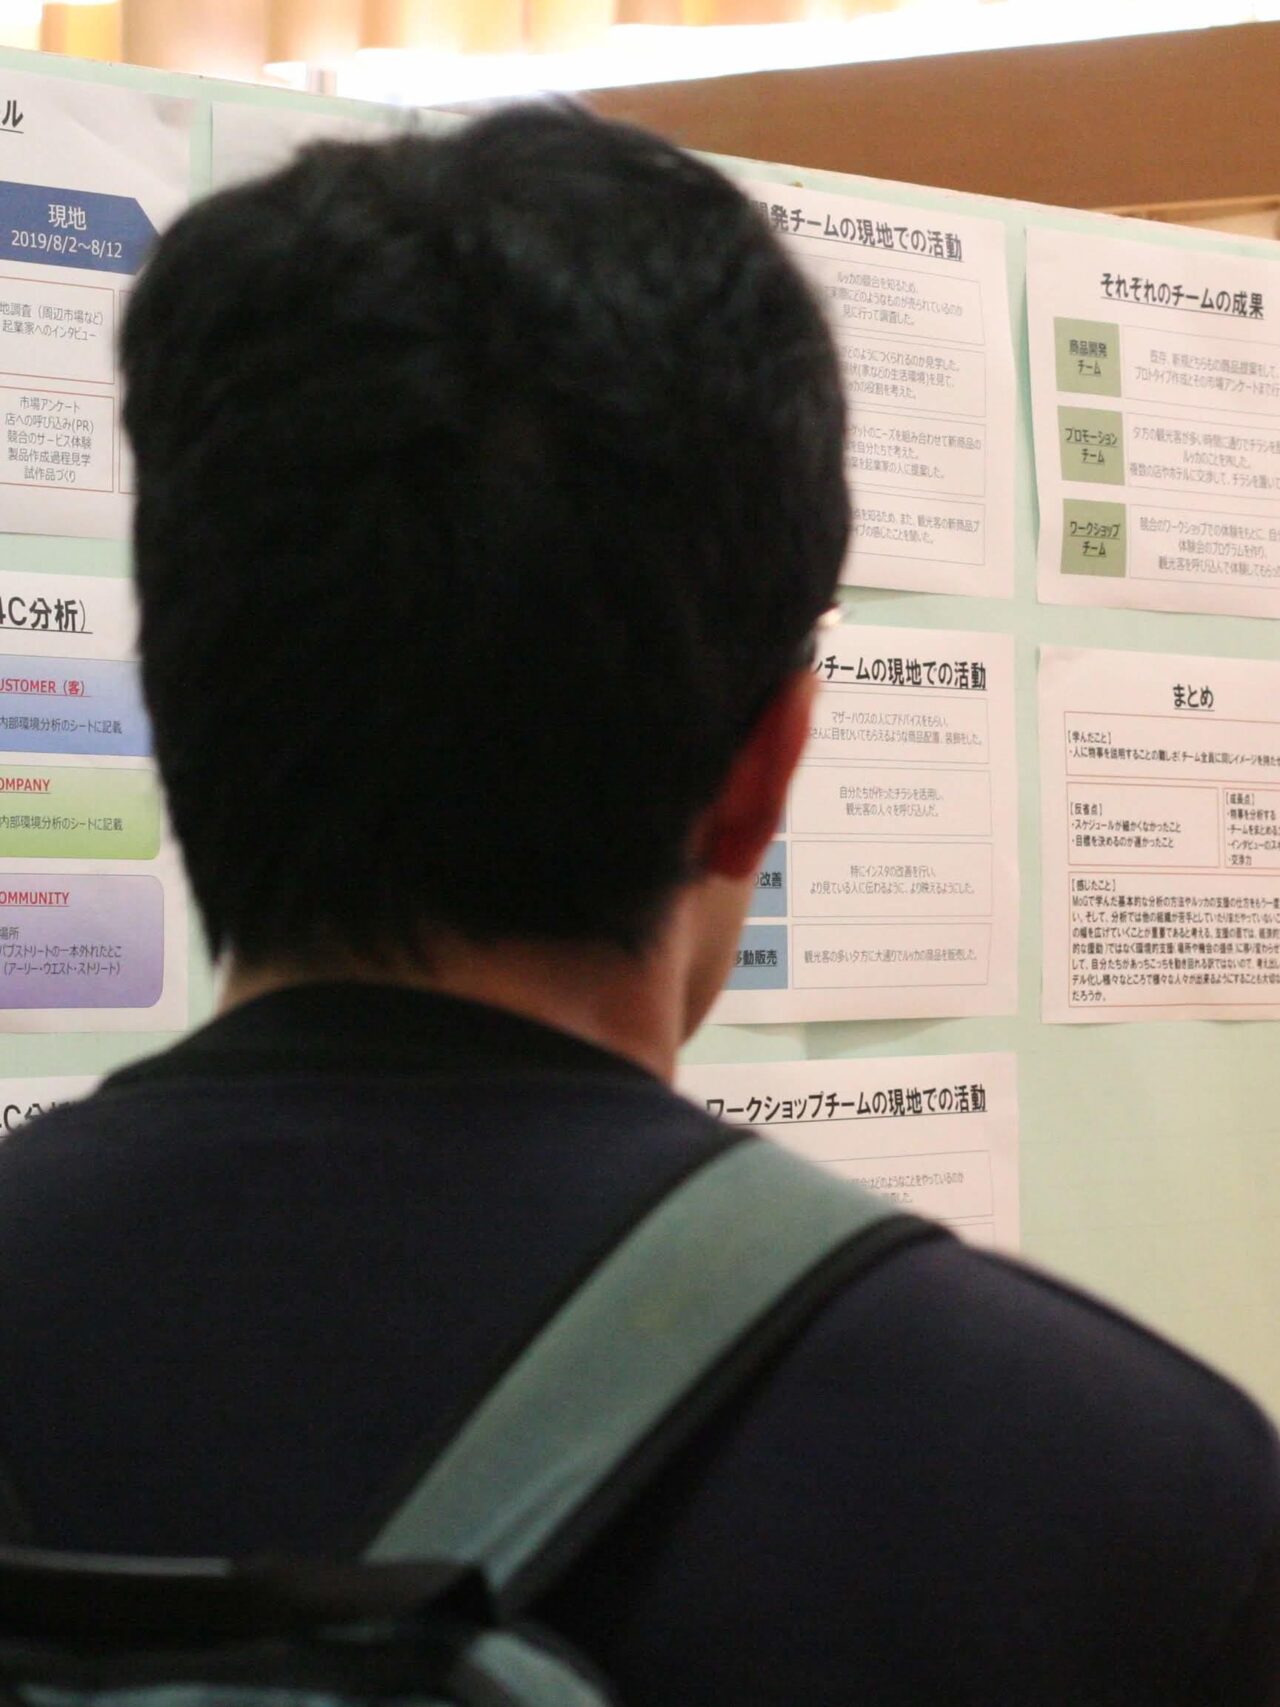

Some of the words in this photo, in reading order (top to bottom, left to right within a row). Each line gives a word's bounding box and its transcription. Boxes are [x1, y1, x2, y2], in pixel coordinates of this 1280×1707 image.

[48, 203, 87, 231] 現地
[1100, 273, 1264, 318] それぞれのチームの成果
[2, 319, 97, 341] 起業家へのインタビュー
[1069, 339, 1107, 358] 商品開発
[1077, 360, 1102, 376] チーム
[20, 397, 80, 414] 市場アンケート
[8, 430, 92, 450] 競合のサービス体験
[1065, 427, 1118, 446] プロモーション
[8, 448, 91, 467] 製品作成過程見学
[1081, 449, 1105, 464] チーム
[24, 467, 76, 483] 試作品づくり
[1070, 521, 1120, 539] ワークショップ
[1082, 541, 1106, 557] チーム
[1172, 684, 1214, 709] まとめ
[0, 716, 122, 735] 内部環境分析のシートに記載
[0, 815, 124, 832] 内部環境分析のシートに記載
[706, 1084, 986, 1122] ワークショップチームの現地での活動
